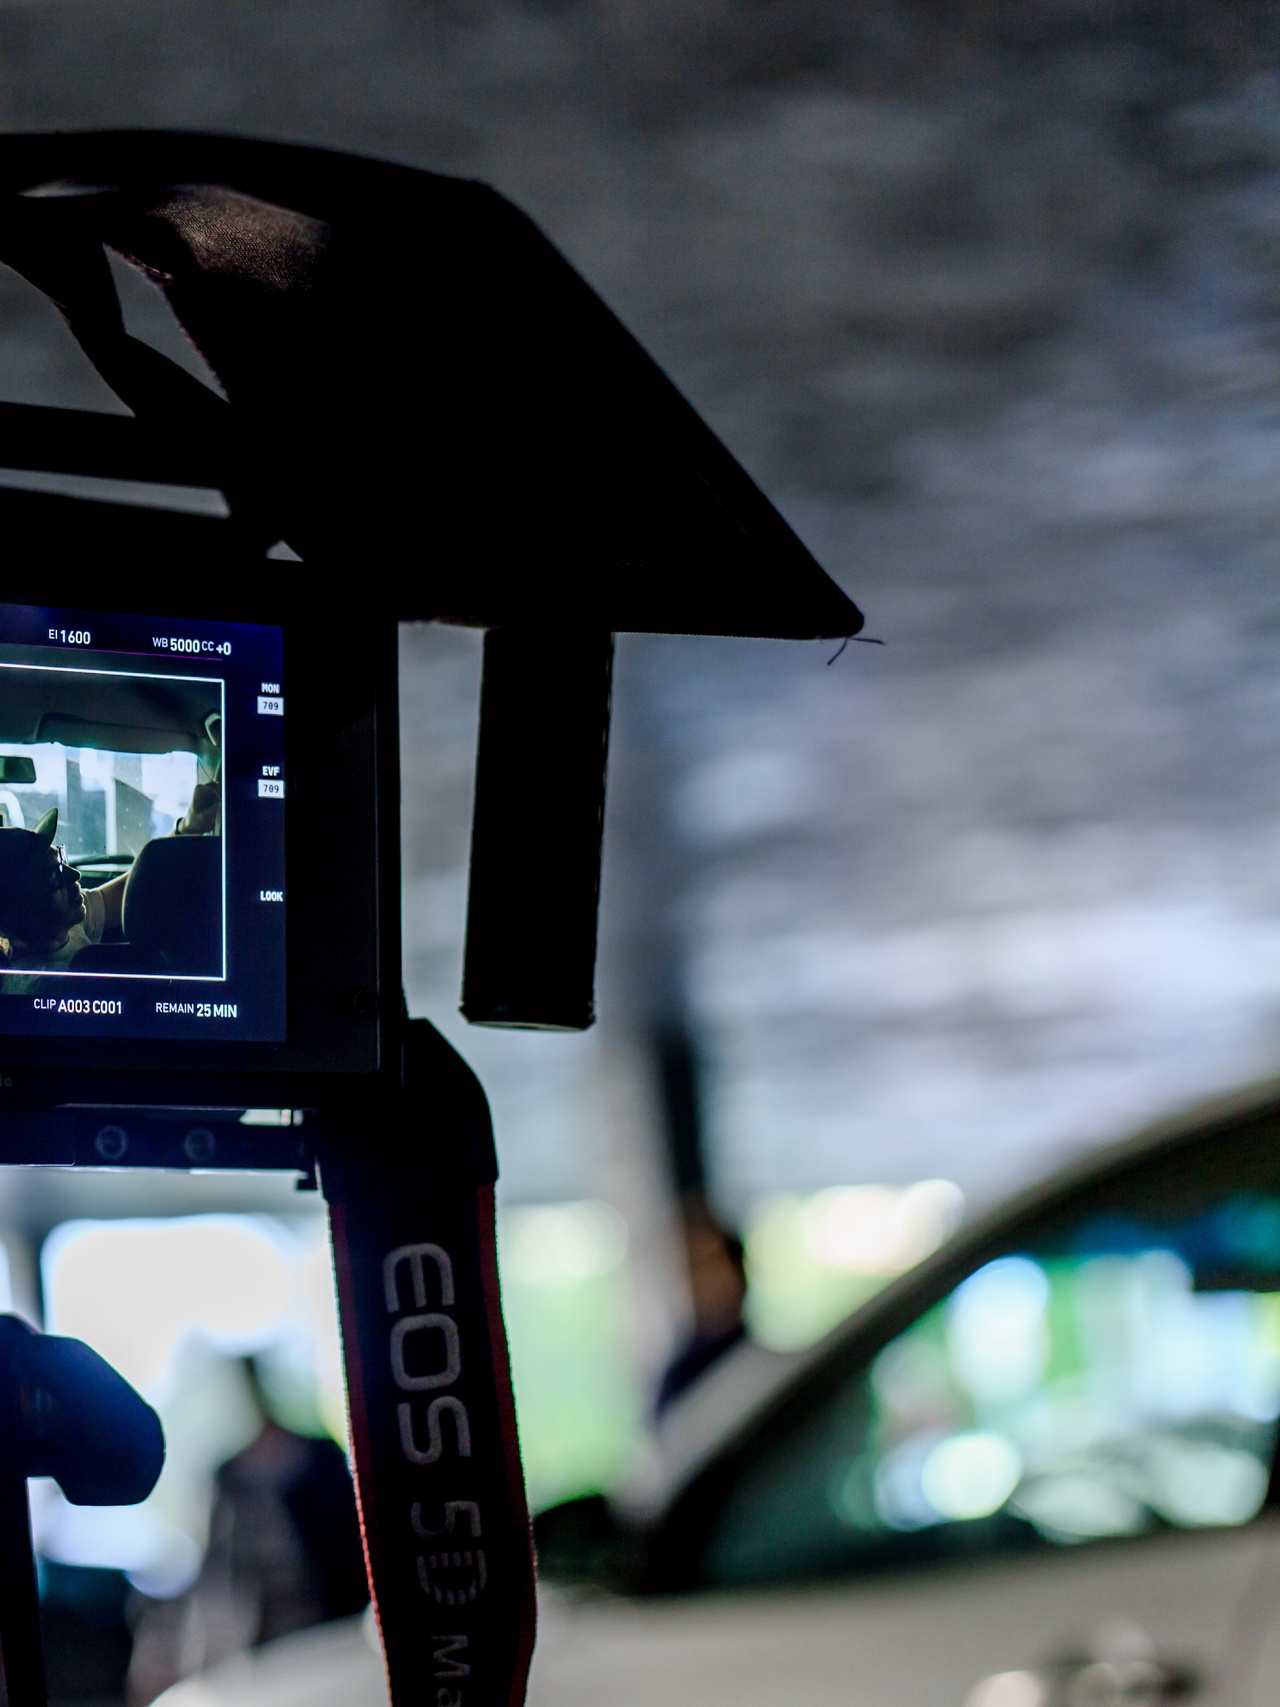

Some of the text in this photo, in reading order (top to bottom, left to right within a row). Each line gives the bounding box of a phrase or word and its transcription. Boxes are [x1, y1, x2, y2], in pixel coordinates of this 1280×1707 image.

[48, 629, 91, 645] EI 1600
[152, 637, 232, 656] WB 5000 CC +0
[261, 682, 280, 694] MON
[262, 701, 279, 711] 709
[262, 765, 280, 777] EVF
[263, 784, 280, 794] 709
[260, 890, 284, 902] LOOK
[33, 998, 122, 1014] CLIP A003 C001
[155, 1002, 238, 1018] REMAIN 25 MIN
[382, 1242, 472, 1466] EOS
[410, 1501, 488, 1605] 5D
